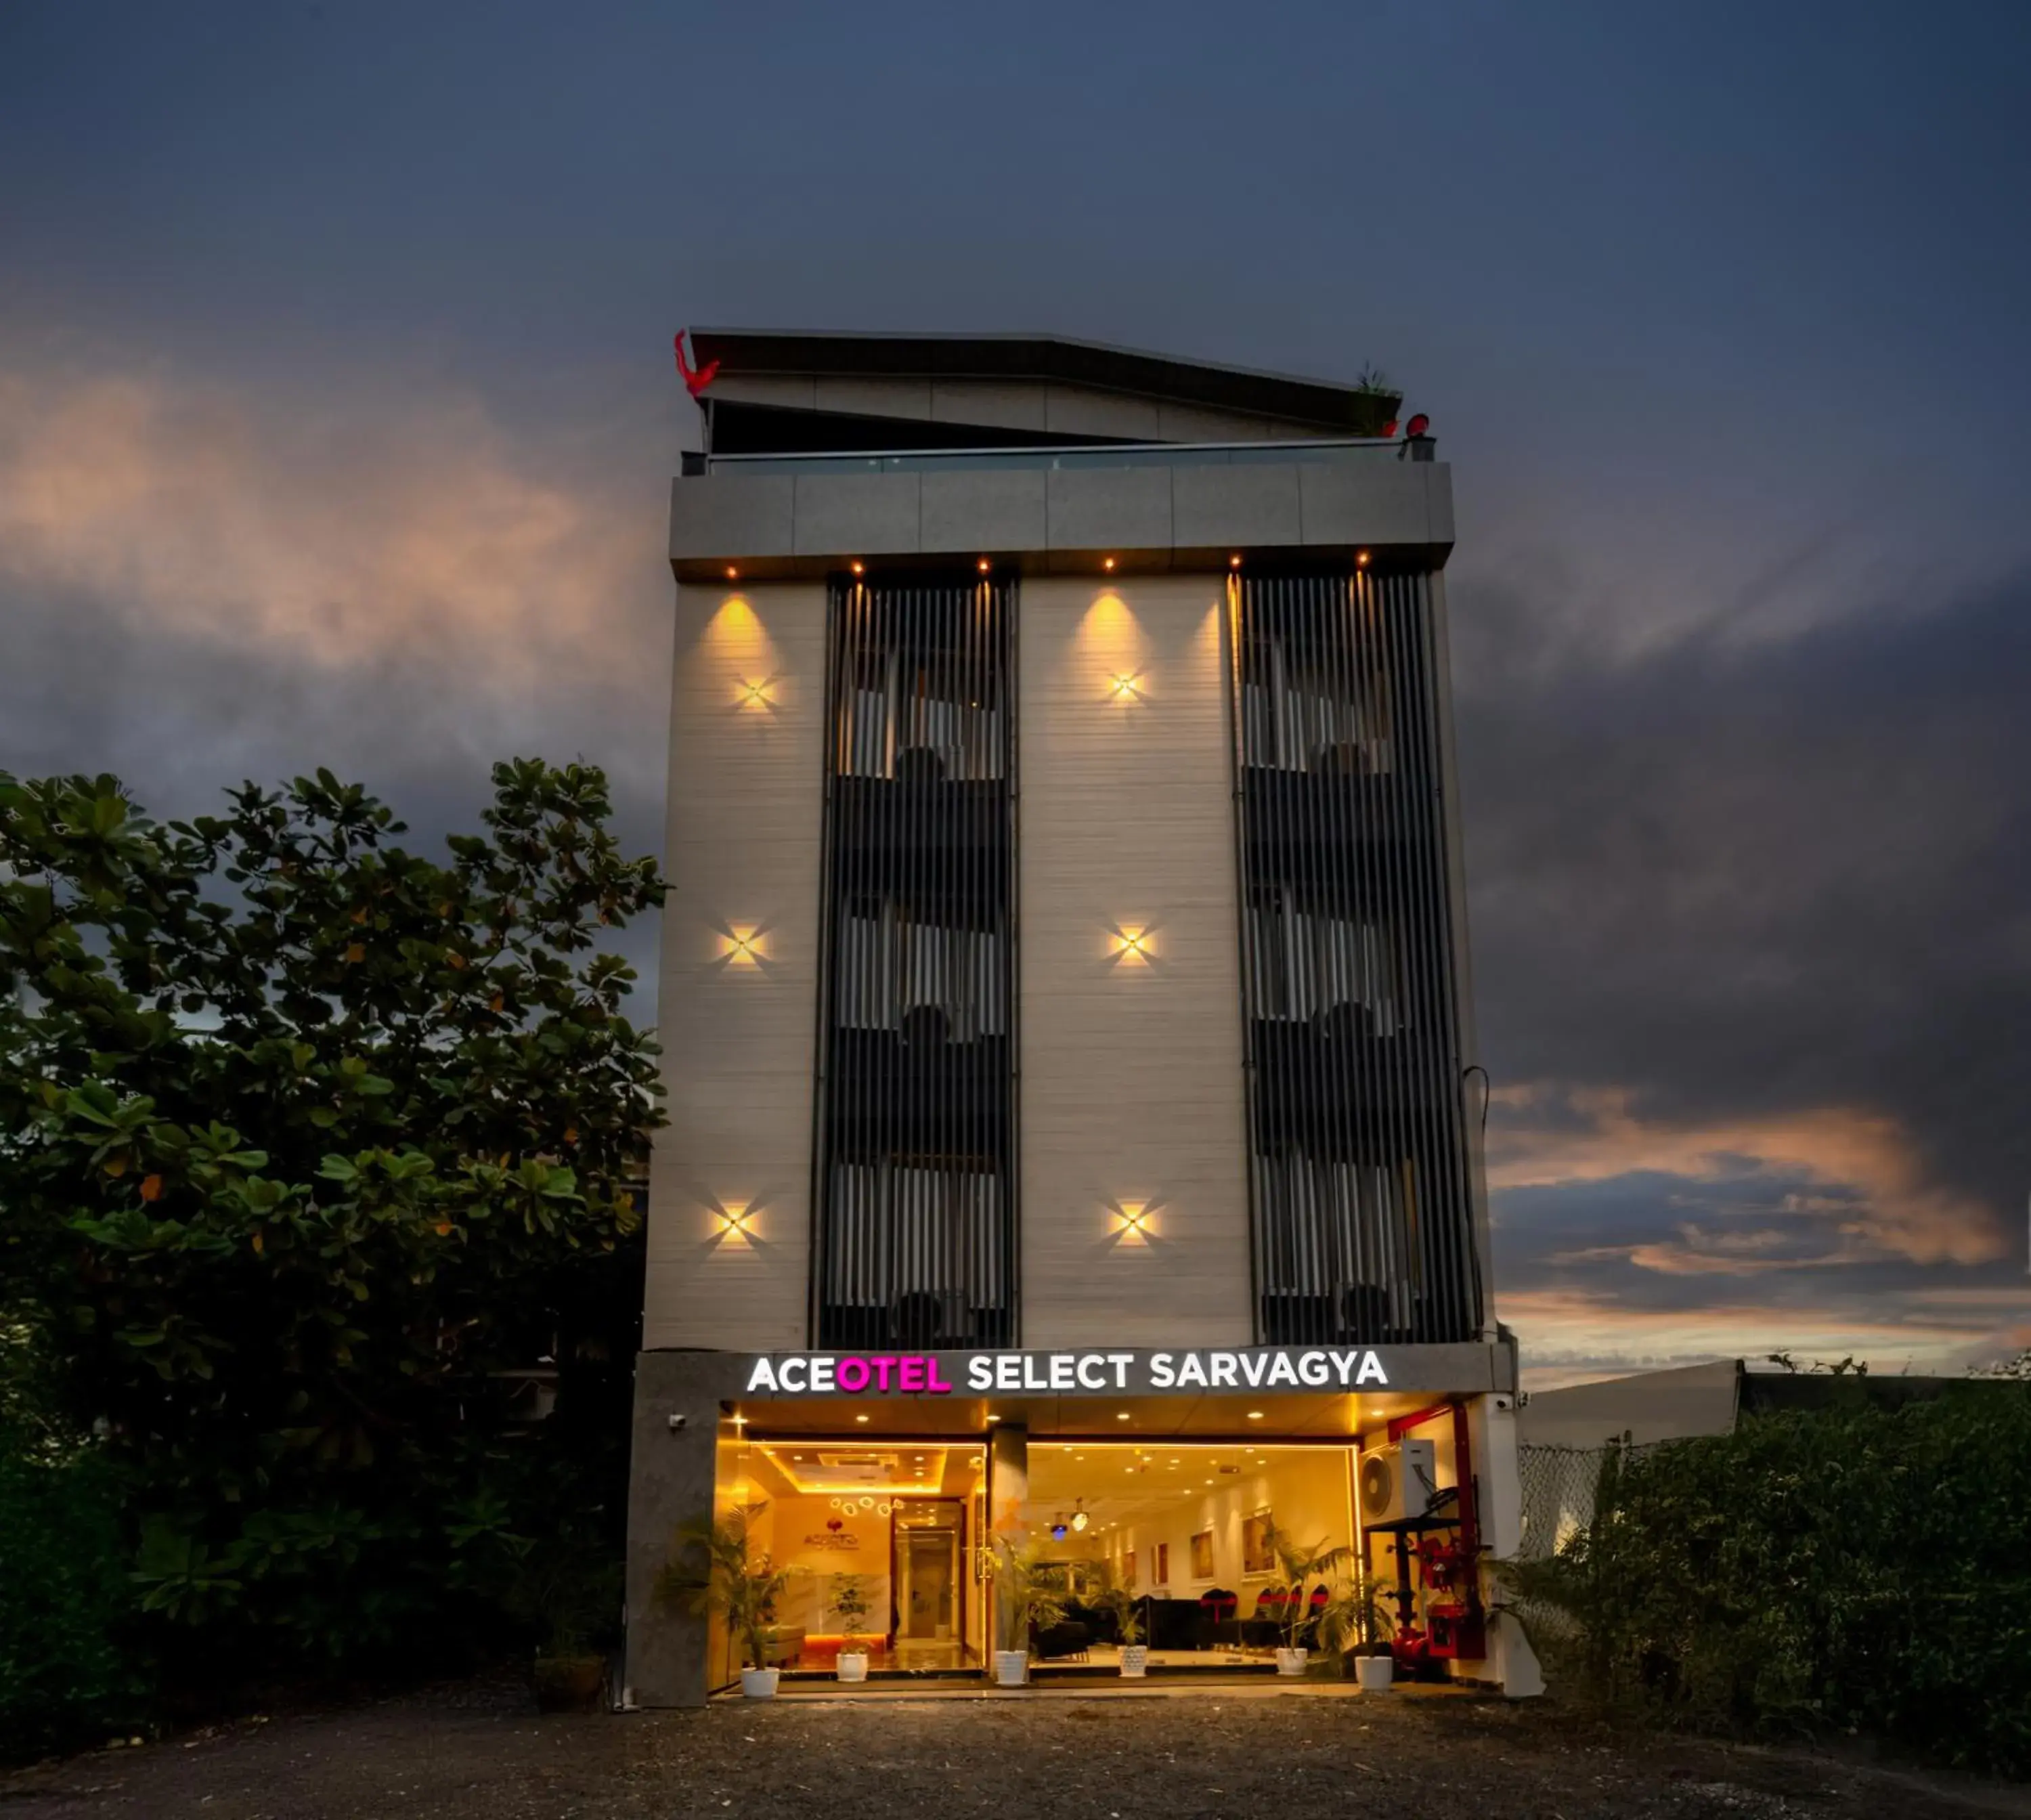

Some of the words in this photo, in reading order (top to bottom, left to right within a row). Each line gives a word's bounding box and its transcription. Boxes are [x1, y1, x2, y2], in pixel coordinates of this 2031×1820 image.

[747, 1356, 952, 1392] ACEOTEL
[967, 1353, 1135, 1390] SELECT
[1149, 1350, 1389, 1388] SARVAGYA
